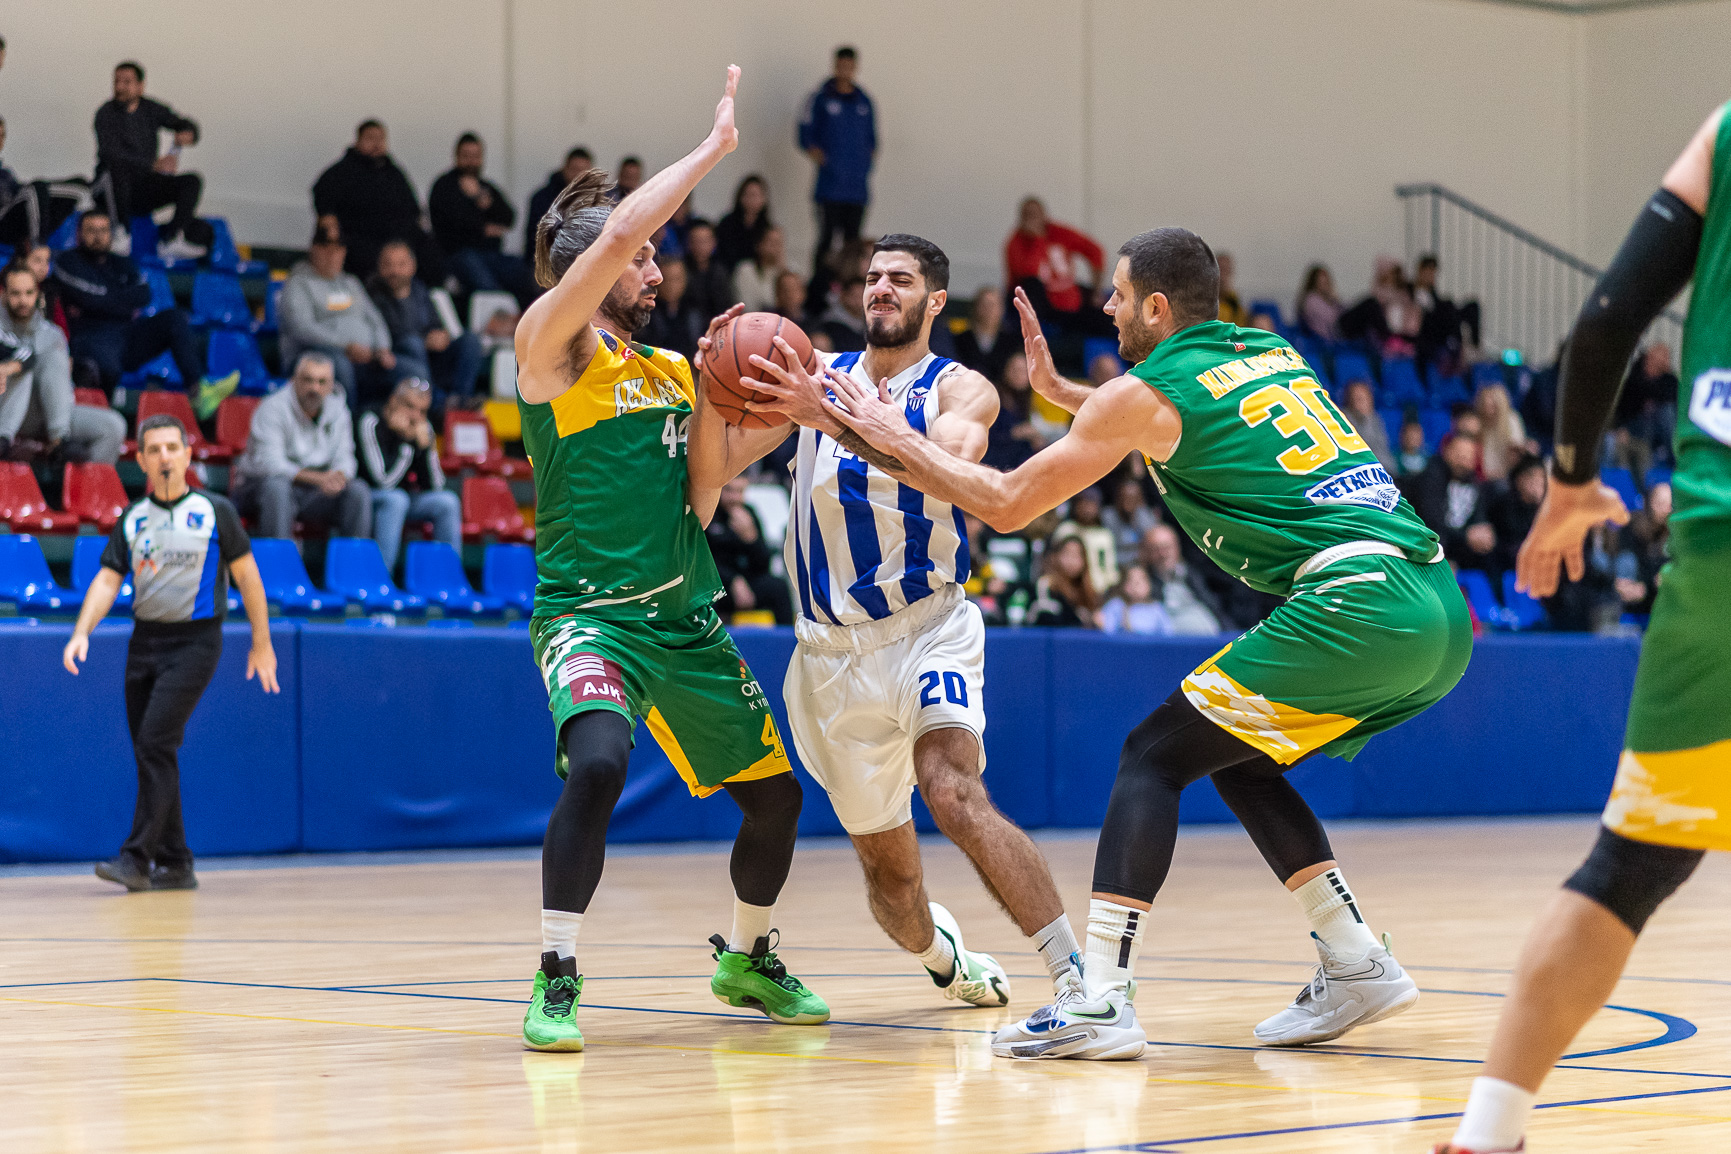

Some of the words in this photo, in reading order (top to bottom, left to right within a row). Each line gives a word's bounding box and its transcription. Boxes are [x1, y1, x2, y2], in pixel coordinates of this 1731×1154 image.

[1238, 376, 1372, 475] 30
[582, 681, 622, 702] AJK
[918, 670, 969, 710] 20
